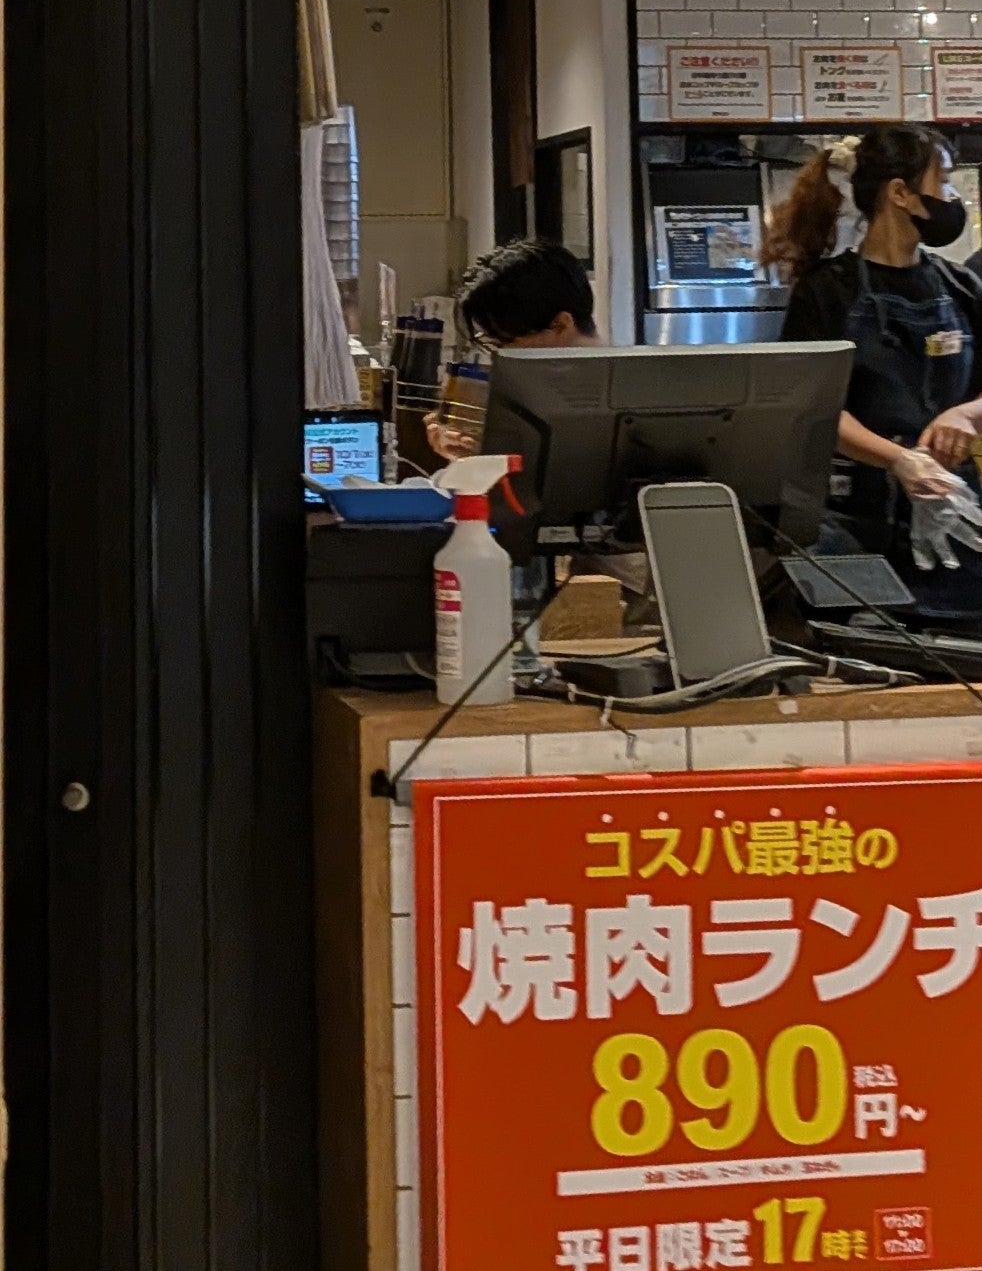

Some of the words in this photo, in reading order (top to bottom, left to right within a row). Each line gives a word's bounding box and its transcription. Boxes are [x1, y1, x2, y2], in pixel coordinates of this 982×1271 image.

[584, 819, 899, 878] コスパ最強の
